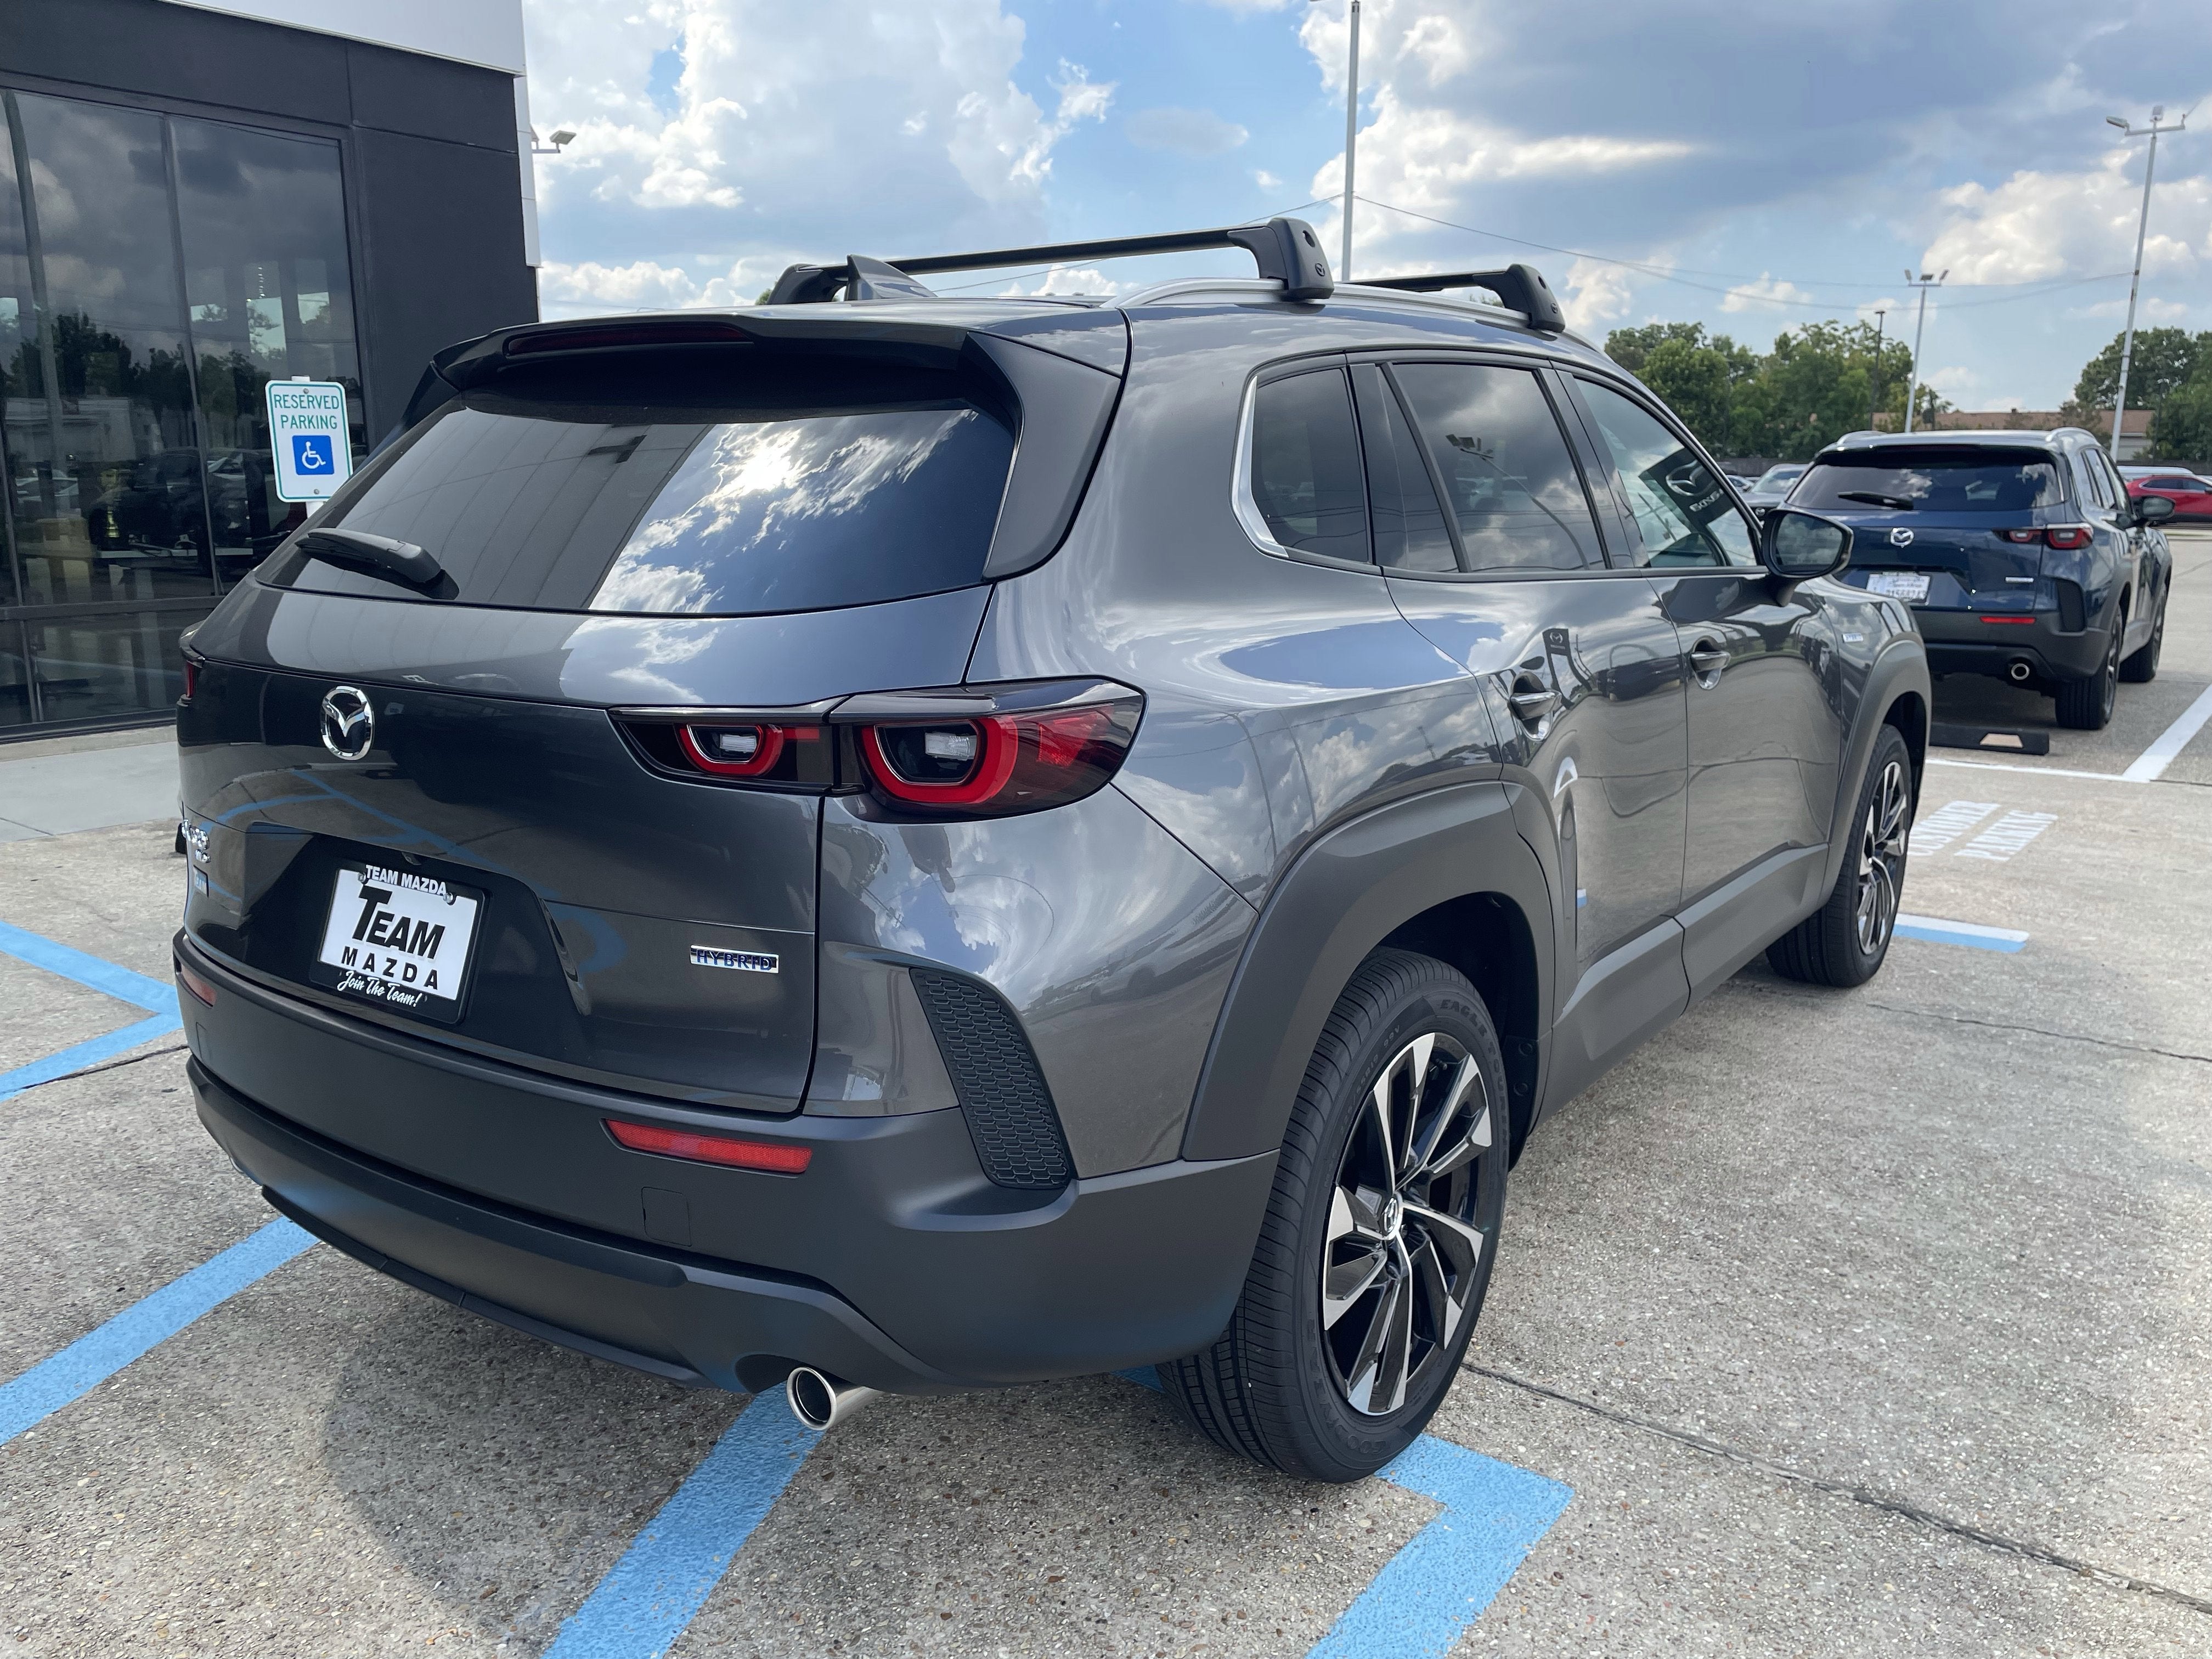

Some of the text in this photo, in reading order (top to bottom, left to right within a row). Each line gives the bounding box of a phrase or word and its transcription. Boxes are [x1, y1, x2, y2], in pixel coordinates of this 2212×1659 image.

[274, 394, 339, 409] RESERVED
[280, 415, 337, 429] PARKING
[1954, 810, 2058, 861] PARKING
[366, 865, 447, 896] TEAM MAZDA
[352, 885, 445, 959] TEAM
[341, 946, 438, 990] MAZDA
[696, 949, 772, 970] HYBRID
[337, 970, 422, 1007] Join The Team!
[1440, 999, 1487, 1037] EAGLE
